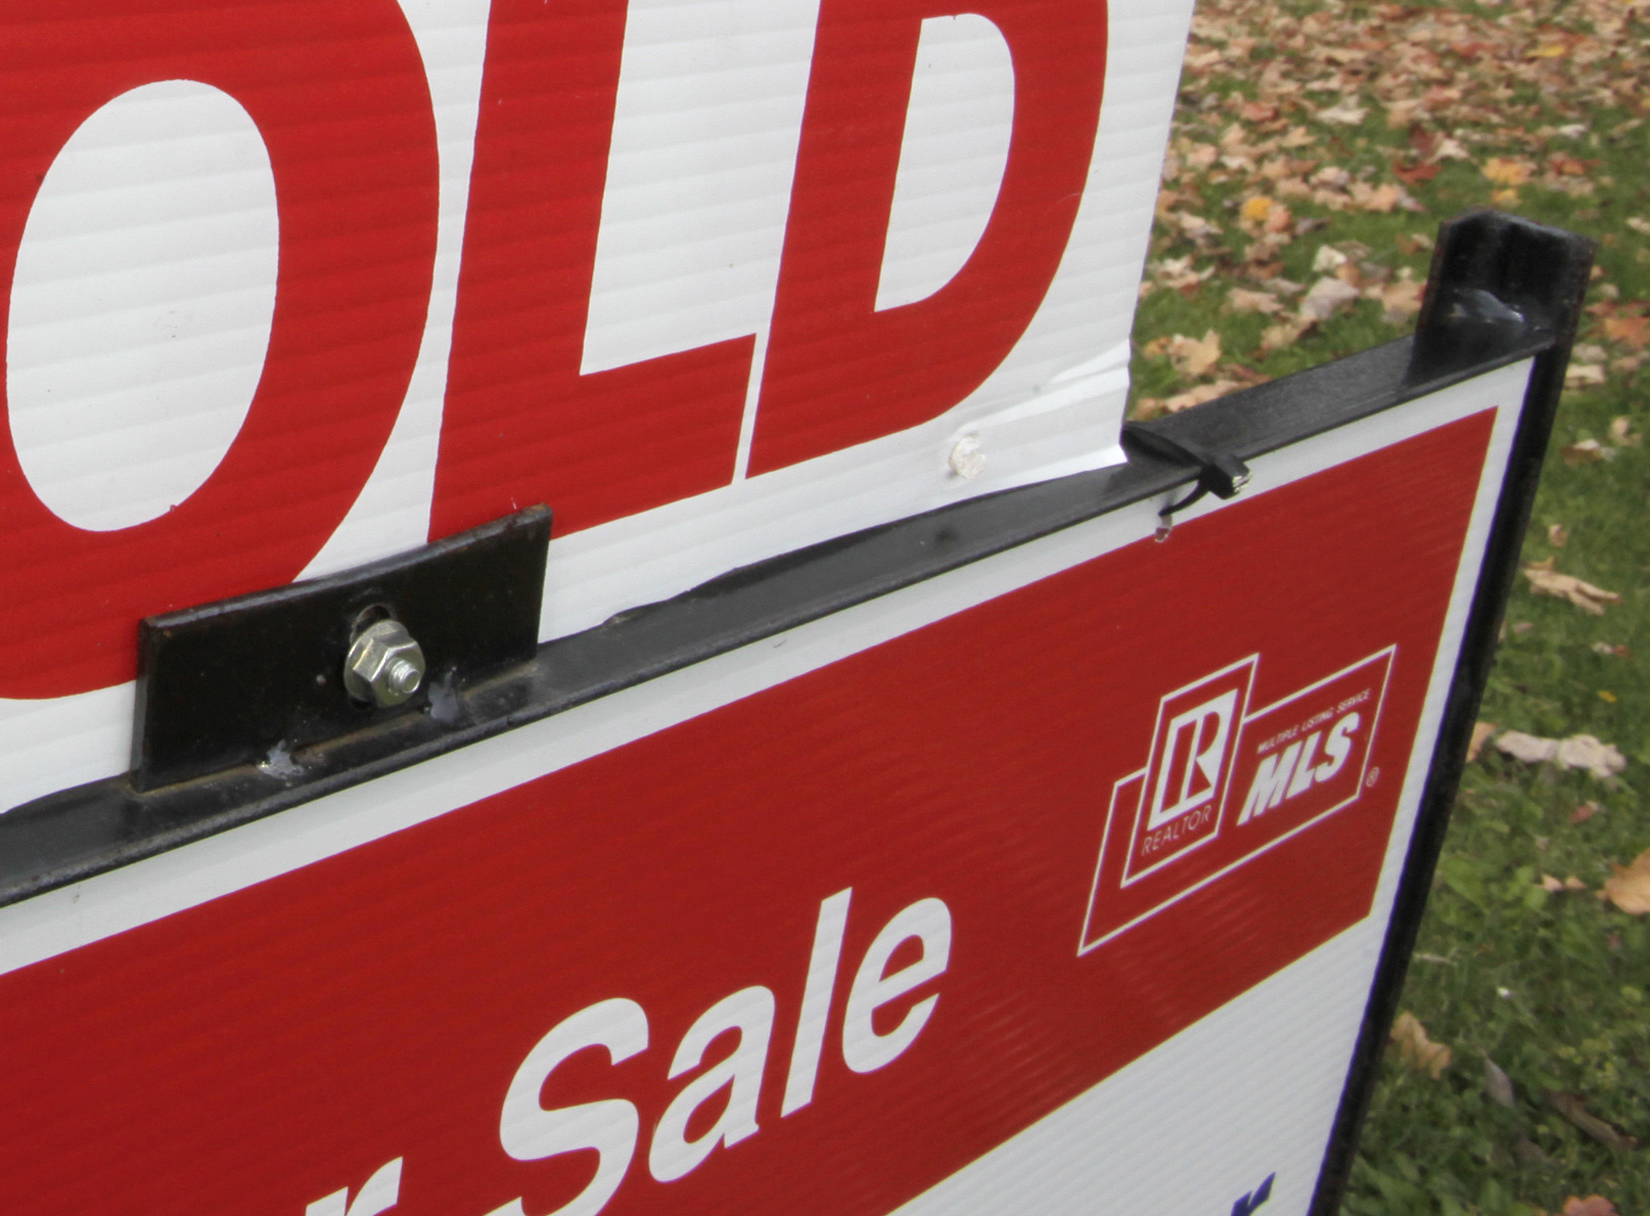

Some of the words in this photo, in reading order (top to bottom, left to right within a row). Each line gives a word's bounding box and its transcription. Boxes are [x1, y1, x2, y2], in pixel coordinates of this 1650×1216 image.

[1236, 710, 1360, 827] MLS
[1141, 804, 1212, 856] REALTOR
[499, 886, 952, 1216] Sale
